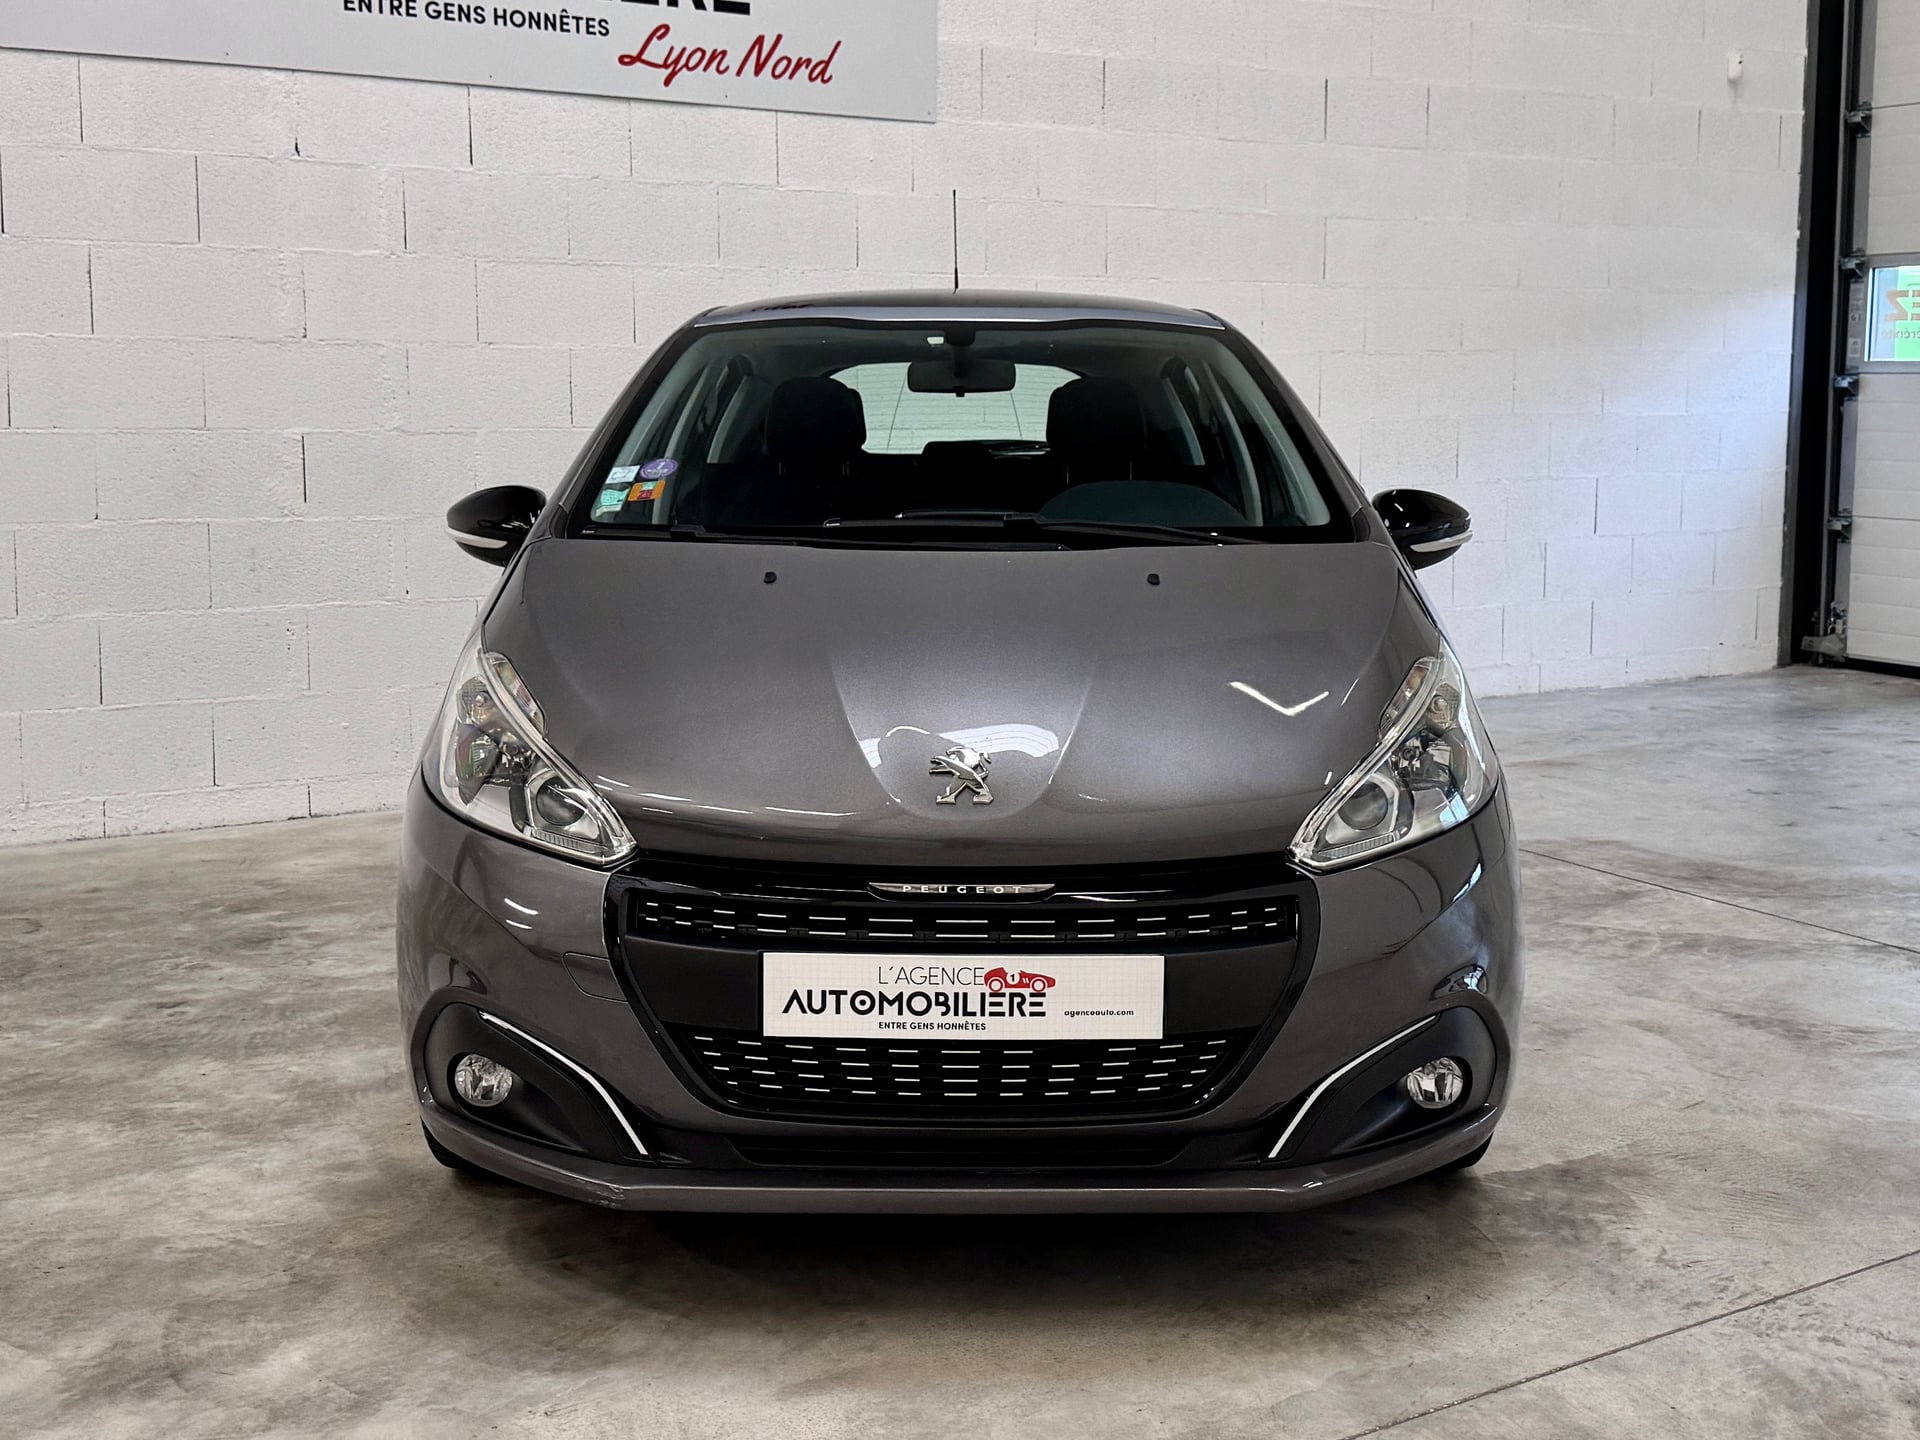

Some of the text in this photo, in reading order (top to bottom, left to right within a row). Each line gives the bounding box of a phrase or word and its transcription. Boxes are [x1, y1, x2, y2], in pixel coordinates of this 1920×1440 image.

[343, 0, 610, 37] ENTRE GENS HONNÊTES
[618, 24, 842, 87] Lyon Nord
[902, 885, 1021, 894] PEUGEOT
[1063, 1009, 1135, 1018] agenceauto.com
[878, 1020, 987, 1031] ENTRE GENS HONNÊTES
